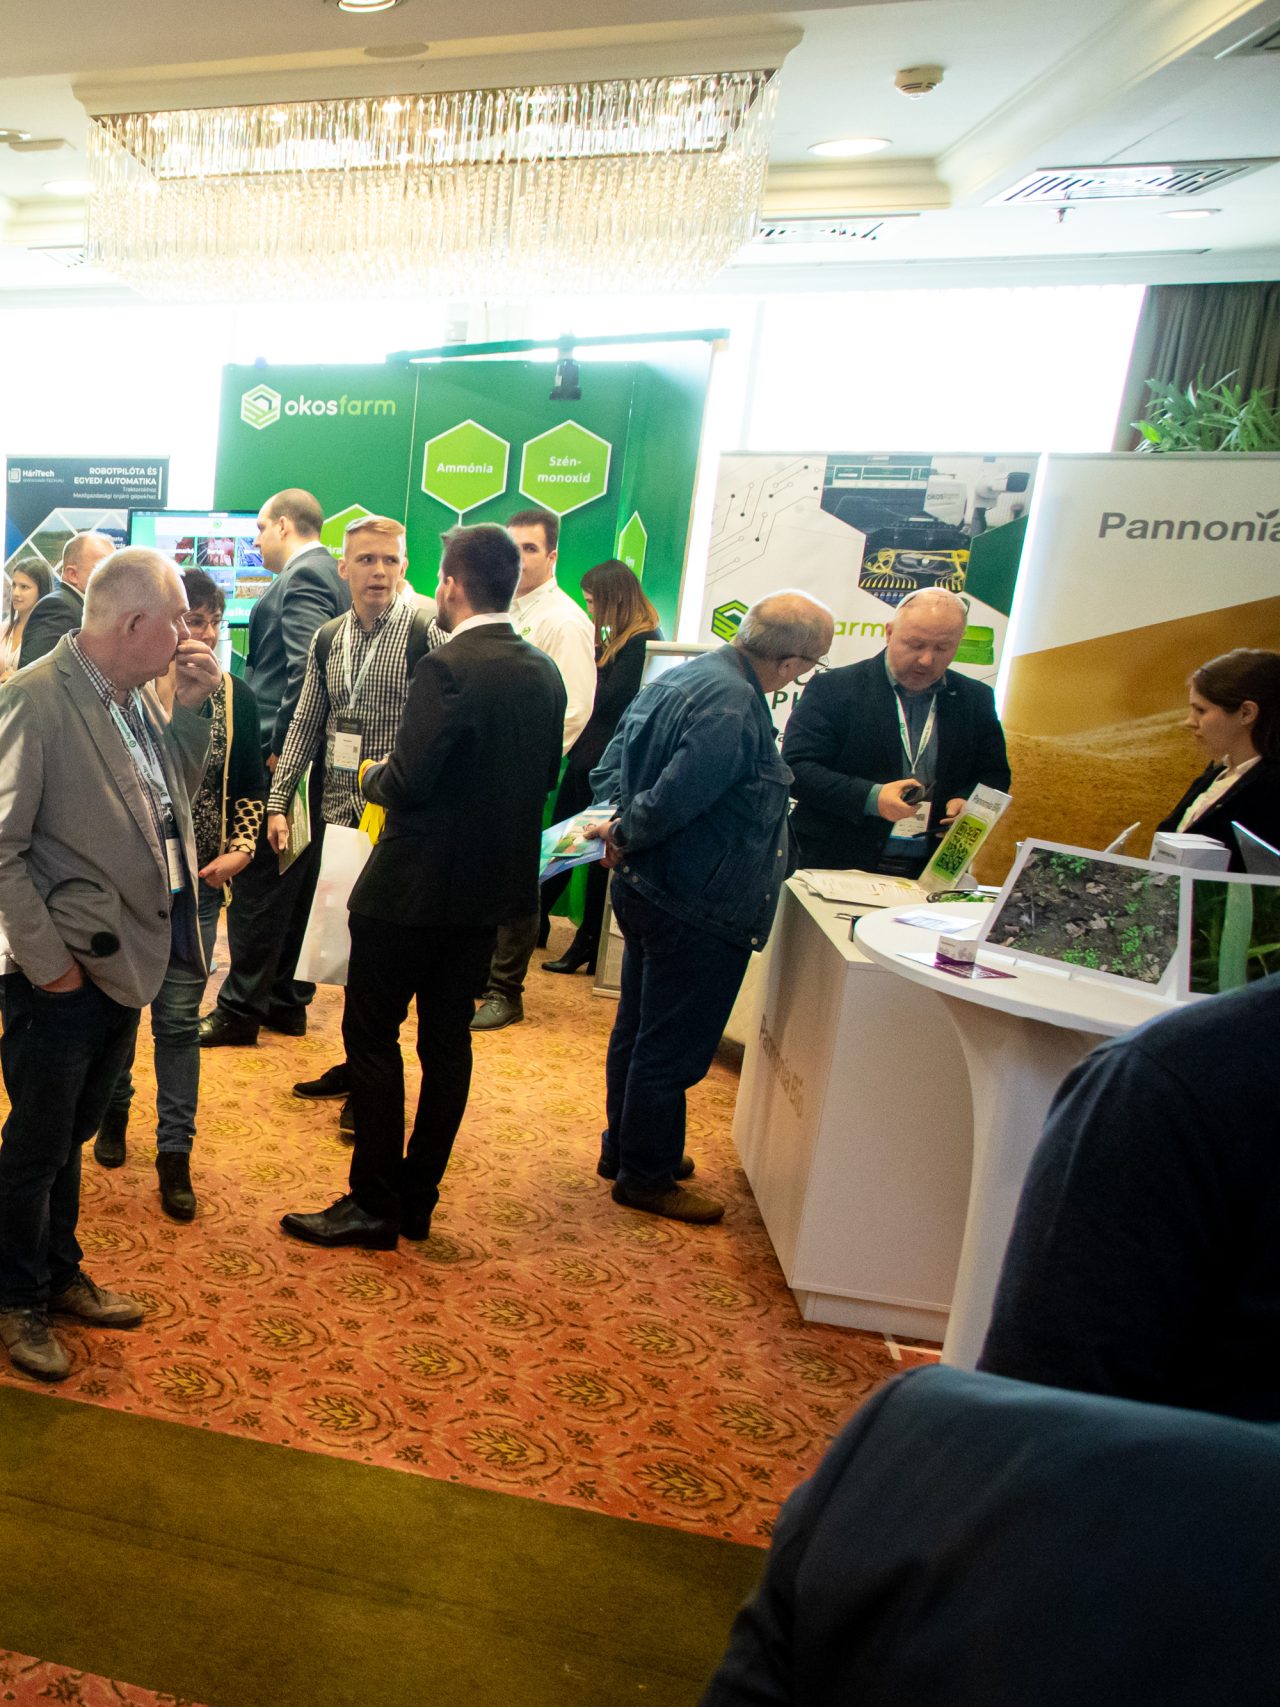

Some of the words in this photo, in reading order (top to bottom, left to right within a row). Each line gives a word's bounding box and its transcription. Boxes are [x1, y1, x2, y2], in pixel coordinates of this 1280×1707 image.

[284, 394, 397, 416] okosfarm
[549, 455, 582, 467] Szén-
[89, 466, 146, 476] ROBOTPILÓTA
[147, 466, 158, 476] ÉS
[436, 462, 494, 474] Ammónia
[74, 477, 103, 485] EGYEDI
[104, 477, 157, 486] AUTOMATIKA
[537, 473, 591, 484] monoxid
[1098, 508, 1280, 542] Pannonia
